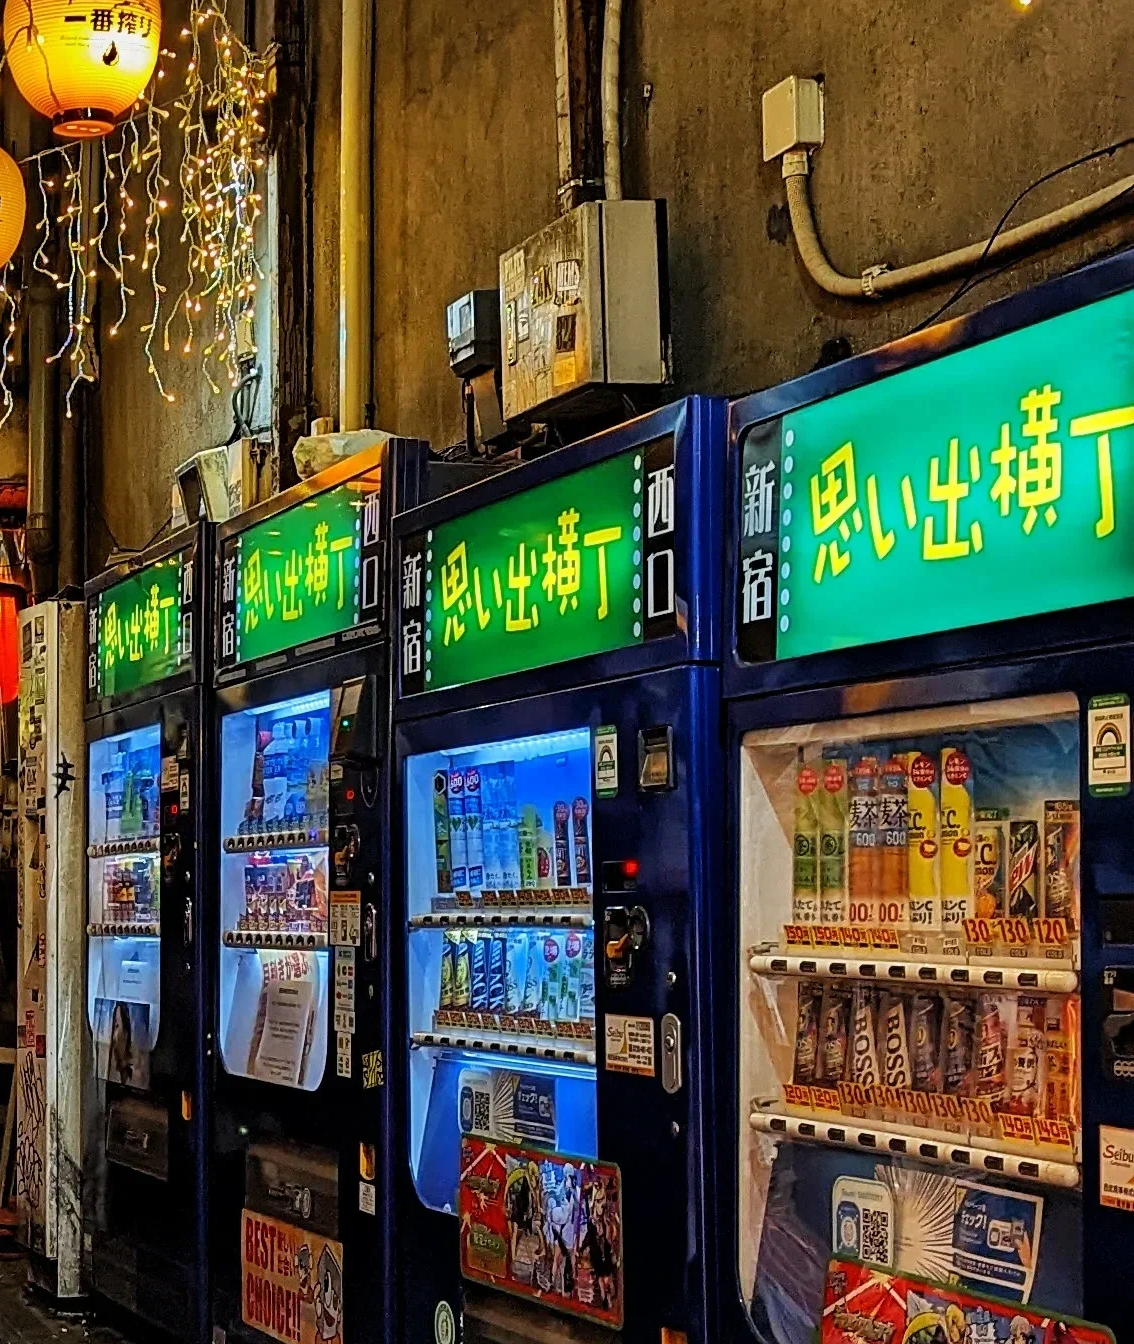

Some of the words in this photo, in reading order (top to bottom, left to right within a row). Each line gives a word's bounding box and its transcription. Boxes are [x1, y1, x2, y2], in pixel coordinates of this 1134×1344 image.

[64, 8, 153, 37] 一番搾り
[809, 384, 1134, 584] 思い出横丁
[243, 521, 353, 633] 思い出横丁
[362, 493, 380, 609] 西口
[441, 507, 622, 646] 思い出横丁
[647, 464, 675, 619] 西口
[742, 460, 776, 624] 新宿
[104, 584, 174, 669] 思い出横丁
[182, 561, 193, 654] 西口
[222, 557, 235, 657] 新宿
[403, 552, 422, 675] 新宿
[88, 608, 97, 688] 新宿
[850, 799, 878, 829] 麦茶
[856, 832, 876, 846] 600
[880, 799, 909, 828] 麦茶
[886, 831, 906, 845] 600
[962, 919, 989, 943] 130
[1034, 919, 1063, 944] 120
[855, 1016, 874, 1087] BOSS
[887, 1013, 906, 1087] BOSS
[245, 1216, 277, 1273] BEST
[246, 1272, 302, 1343] CHOICE!!
